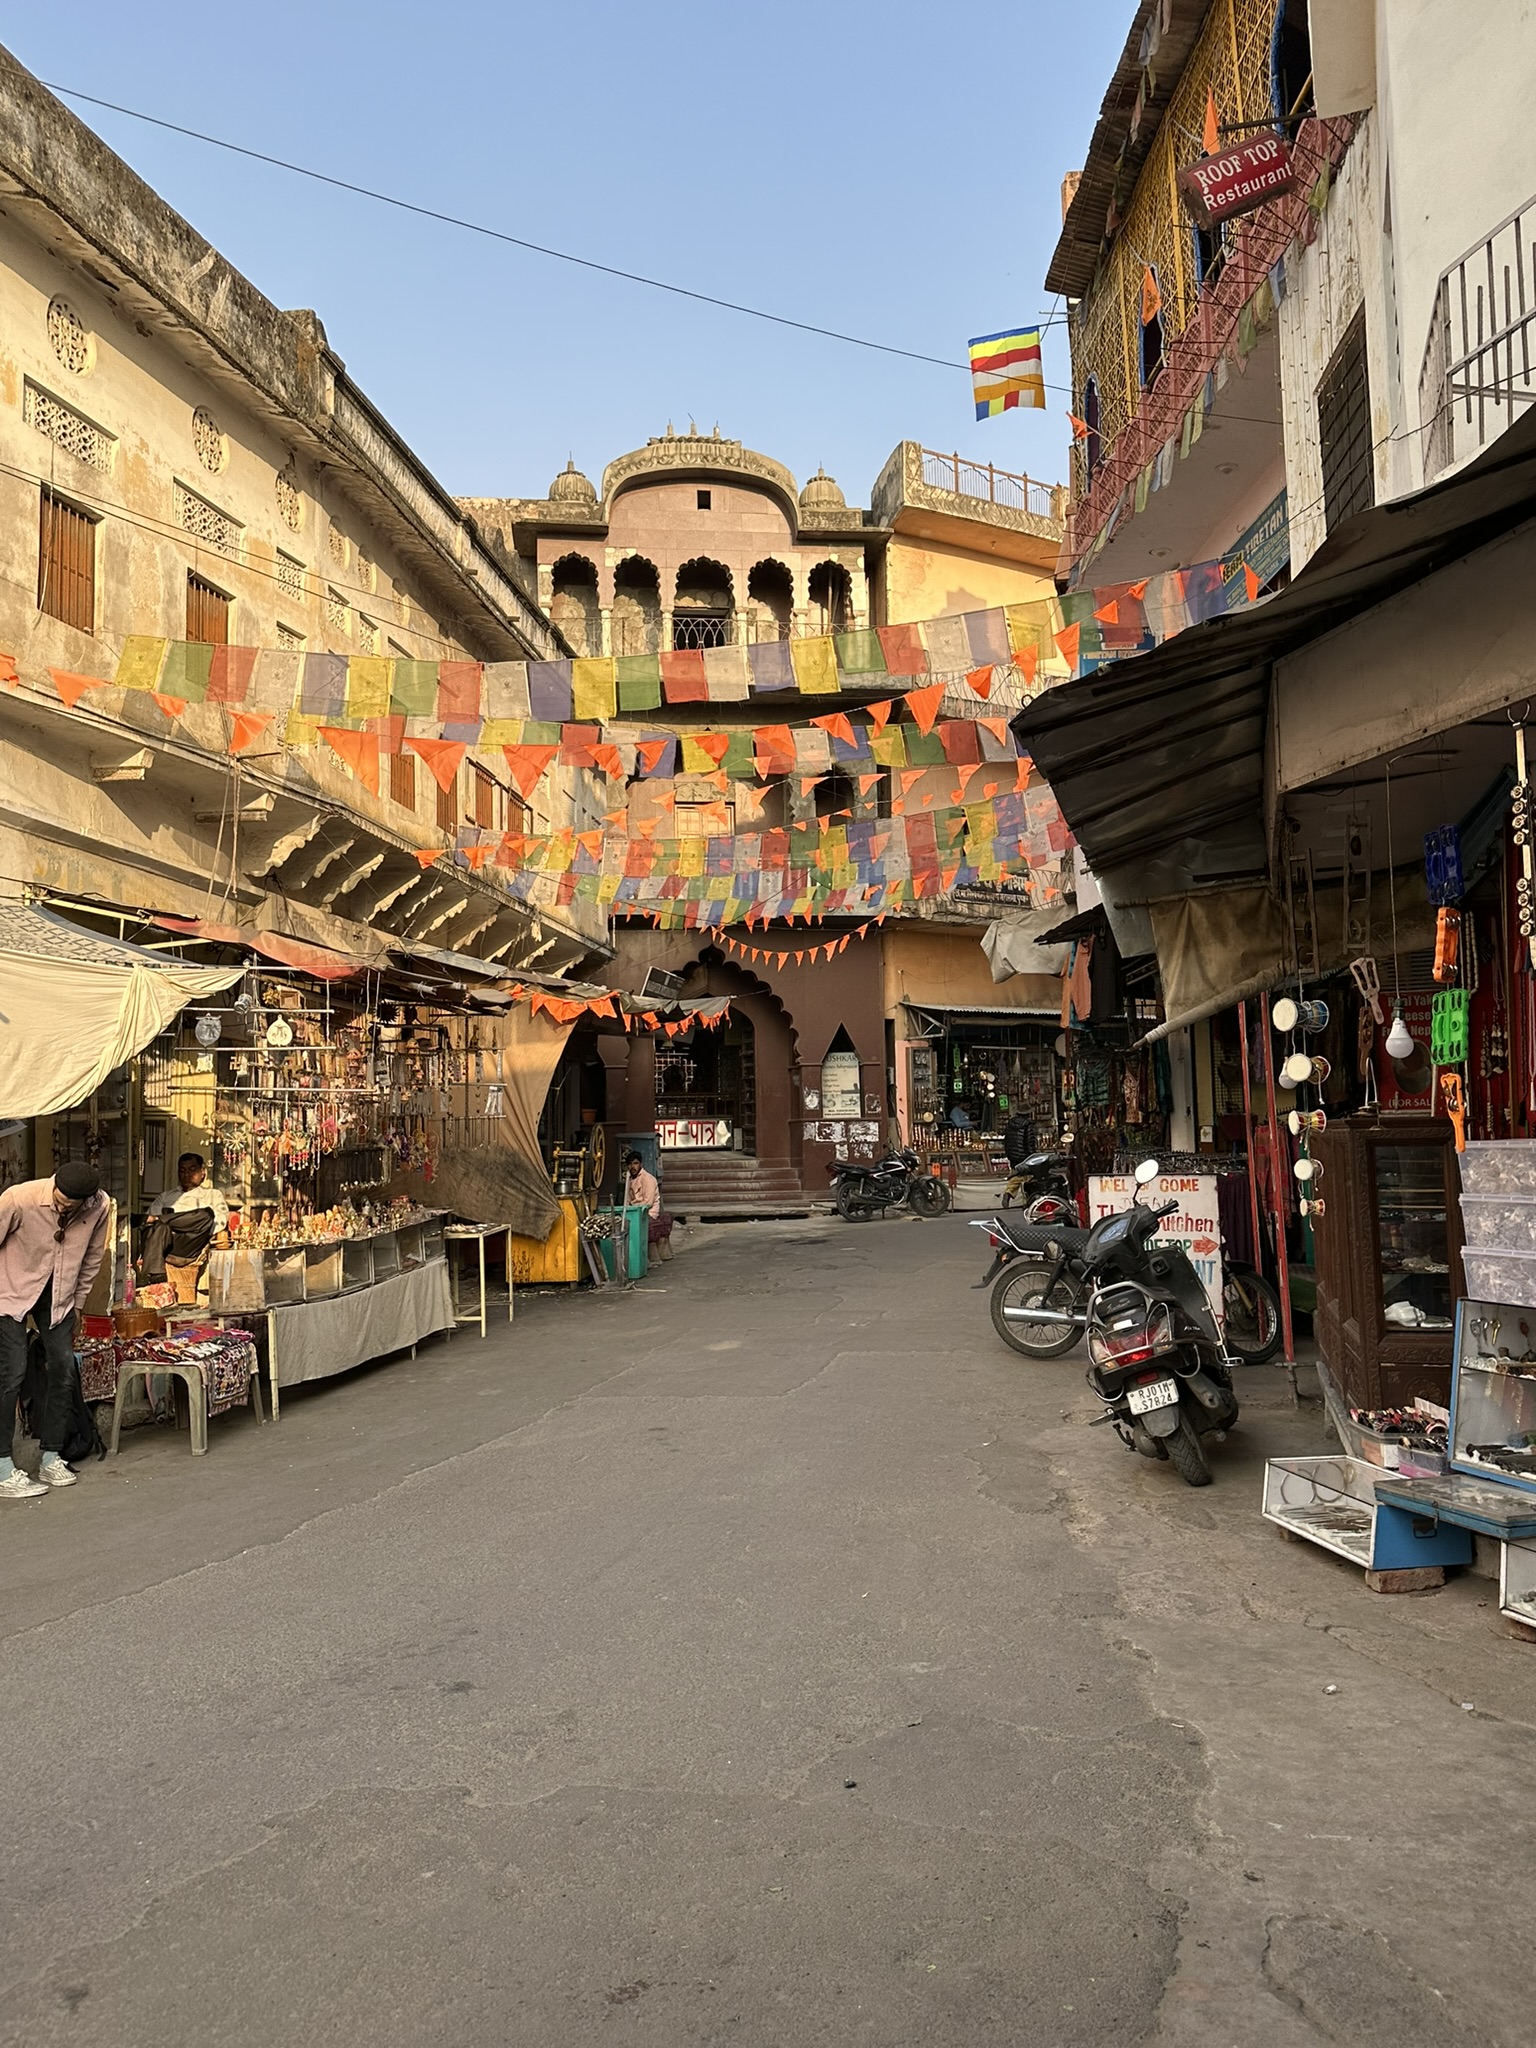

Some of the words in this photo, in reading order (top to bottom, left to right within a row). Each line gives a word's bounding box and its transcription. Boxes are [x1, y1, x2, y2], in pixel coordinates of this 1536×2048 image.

[1194, 155, 1242, 189] ROOF
[1243, 140, 1278, 166] TOP
[1203, 162, 1293, 211] Restaurant
[826, 1053, 857, 1063] USHKAR
[1414, 1097, 1431, 1107] SAL
[1100, 1178, 1129, 1192] WEL
